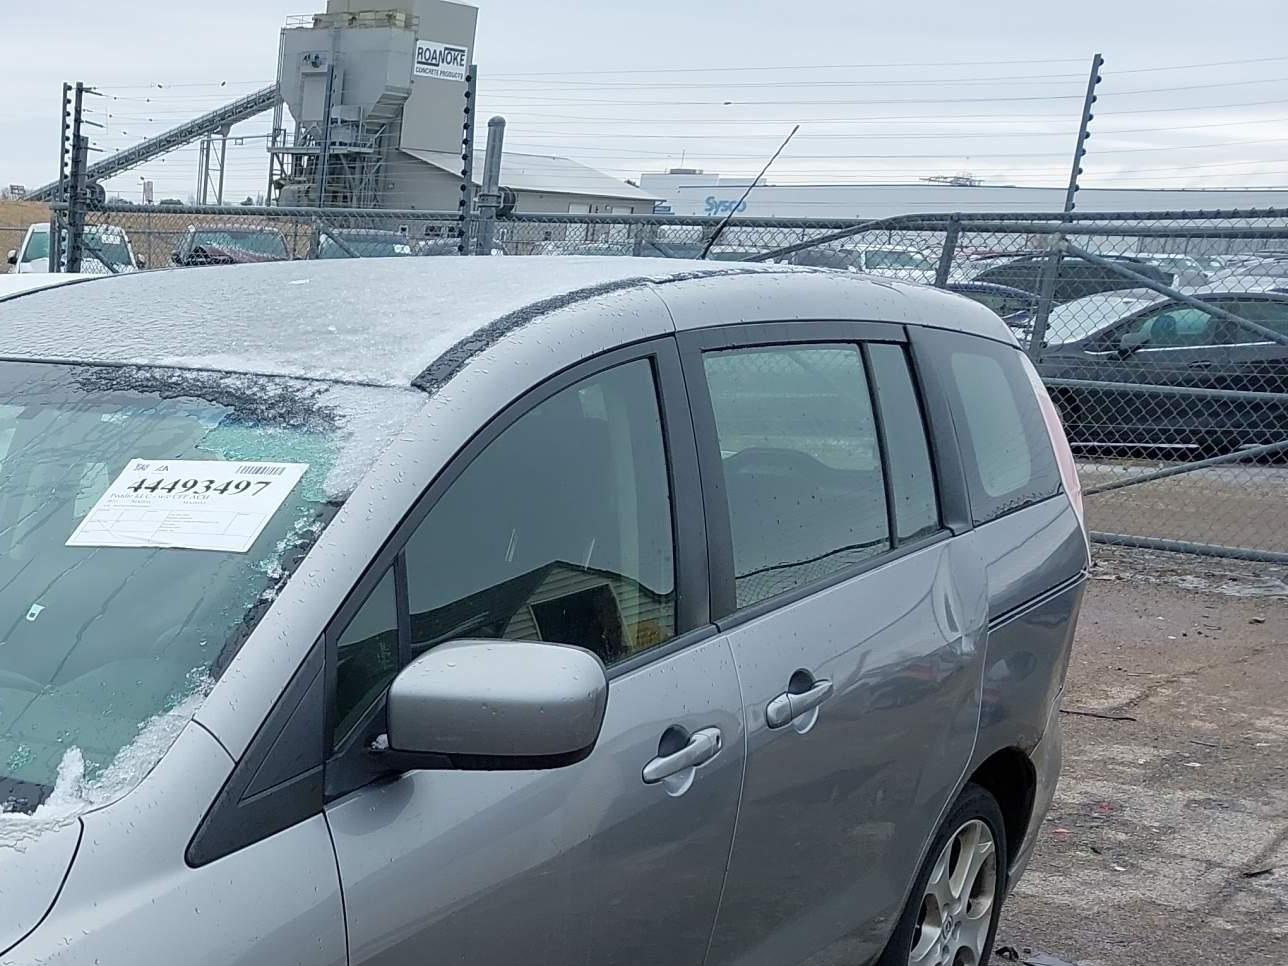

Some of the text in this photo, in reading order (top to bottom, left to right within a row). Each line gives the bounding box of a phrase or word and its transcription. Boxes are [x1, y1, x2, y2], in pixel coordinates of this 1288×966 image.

[417, 47, 465, 67] ROANOKE
[704, 196, 747, 216] Sysco
[127, 478, 272, 496] 44493497
